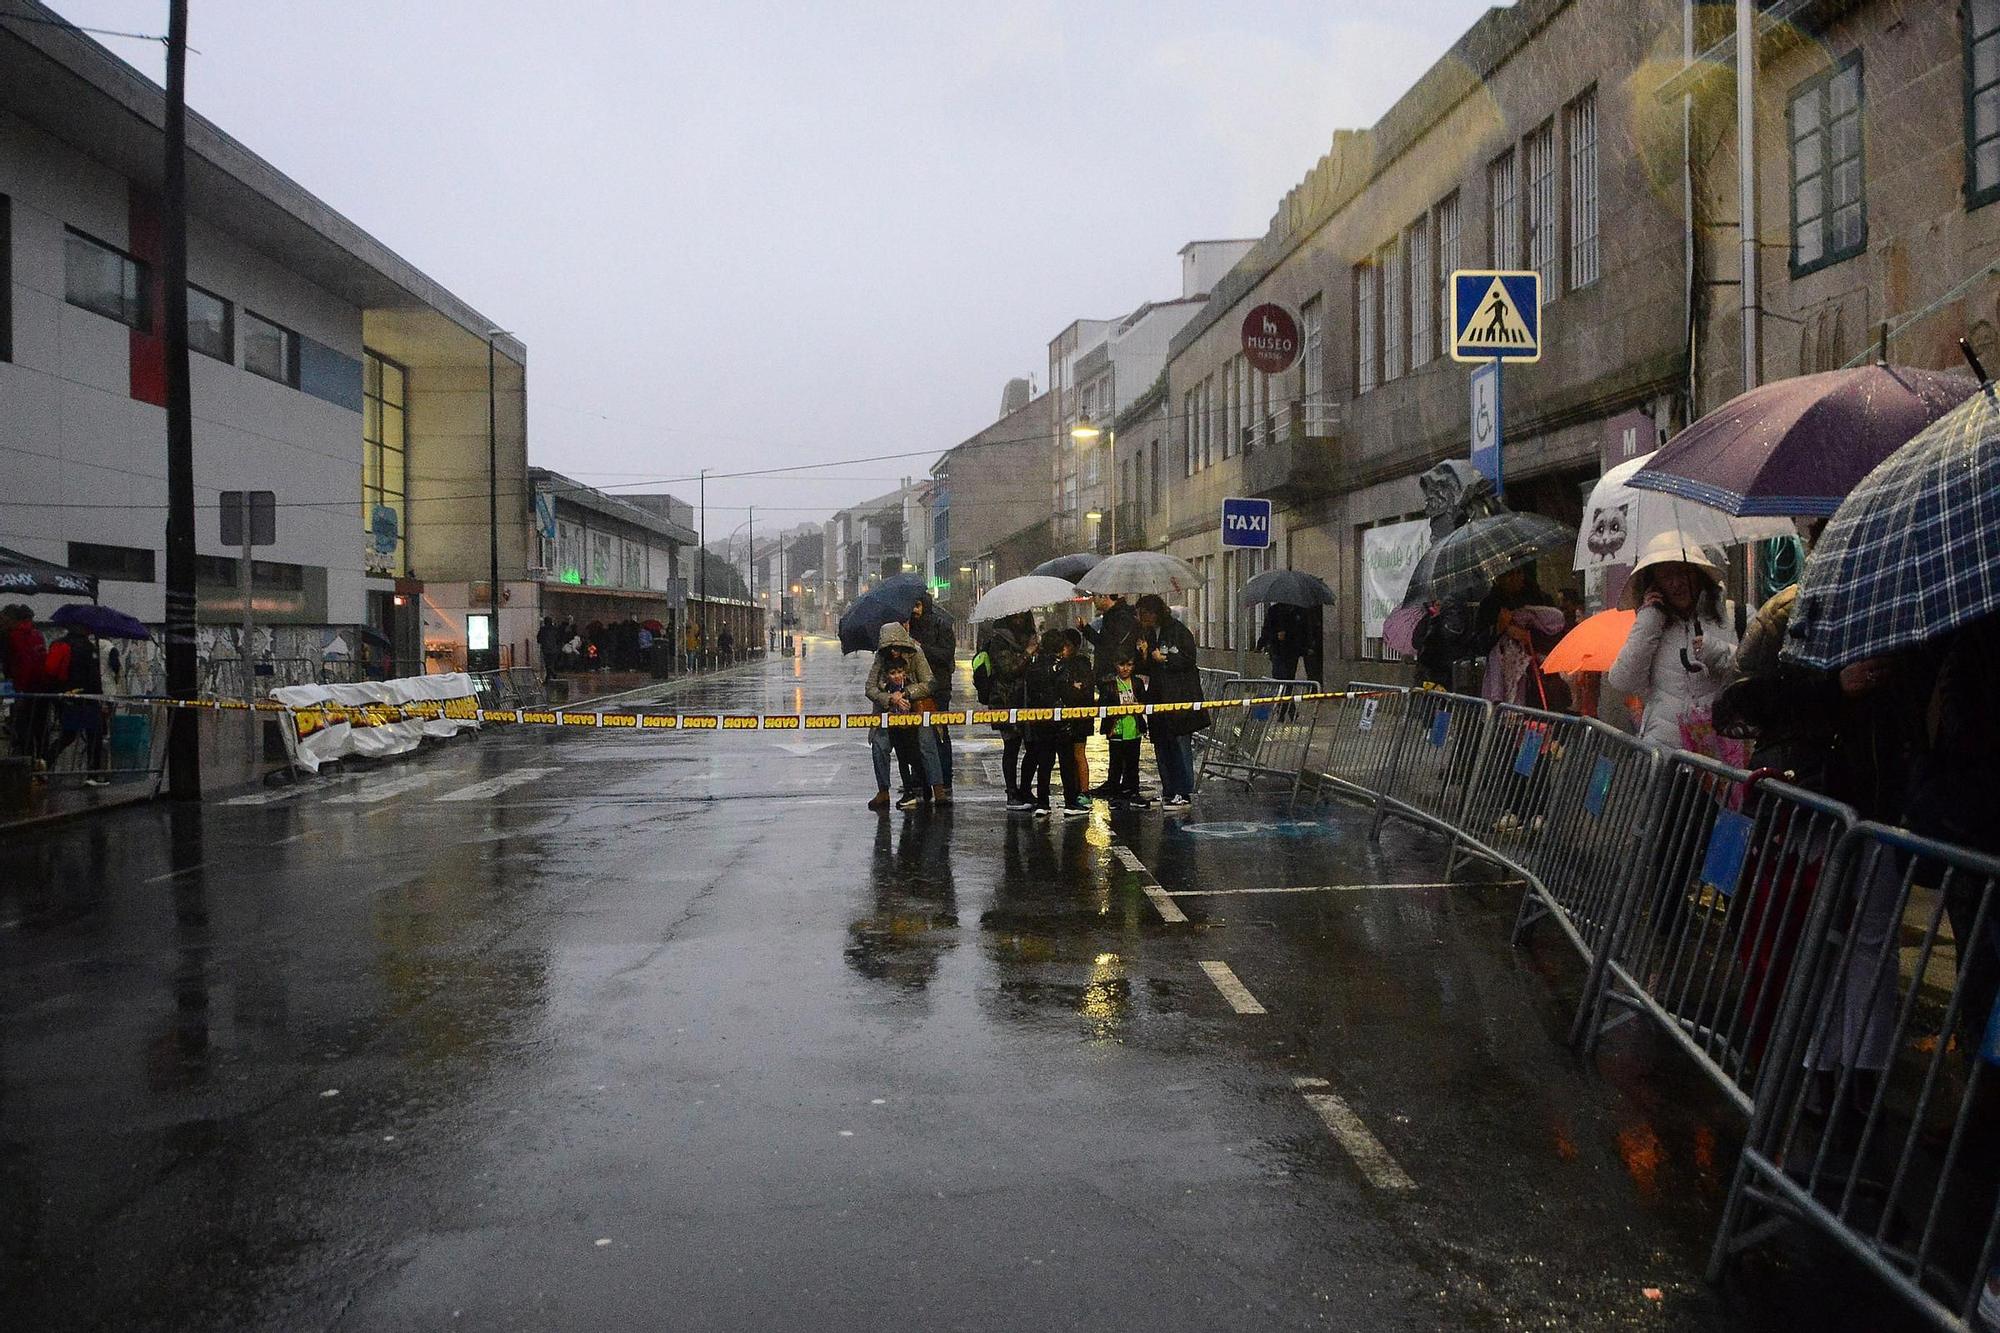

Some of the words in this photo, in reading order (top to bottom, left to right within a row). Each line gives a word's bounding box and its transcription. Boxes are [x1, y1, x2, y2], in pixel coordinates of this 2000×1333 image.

[1248, 336, 1292, 350] MUSEO
[1623, 427, 1637, 456] M
[1227, 514, 1266, 530] TAXI
[483, 711, 516, 721] GADIS
[523, 711, 556, 724] GADIS
[563, 714, 596, 724] GADIS
[930, 713, 965, 725] GADIS
[973, 710, 1009, 723] GADIS
[1017, 708, 1053, 721] GADIS
[1061, 707, 1099, 719] GADIS
[603, 715, 636, 726] GADIS
[643, 716, 677, 727] GADIS
[683, 717, 717, 728] GADIS
[723, 717, 758, 728] GADIS
[764, 717, 798, 728] GADIS
[806, 716, 840, 728] GADIS
[847, 715, 881, 727] GADIS
[888, 714, 922, 726] GADIS
